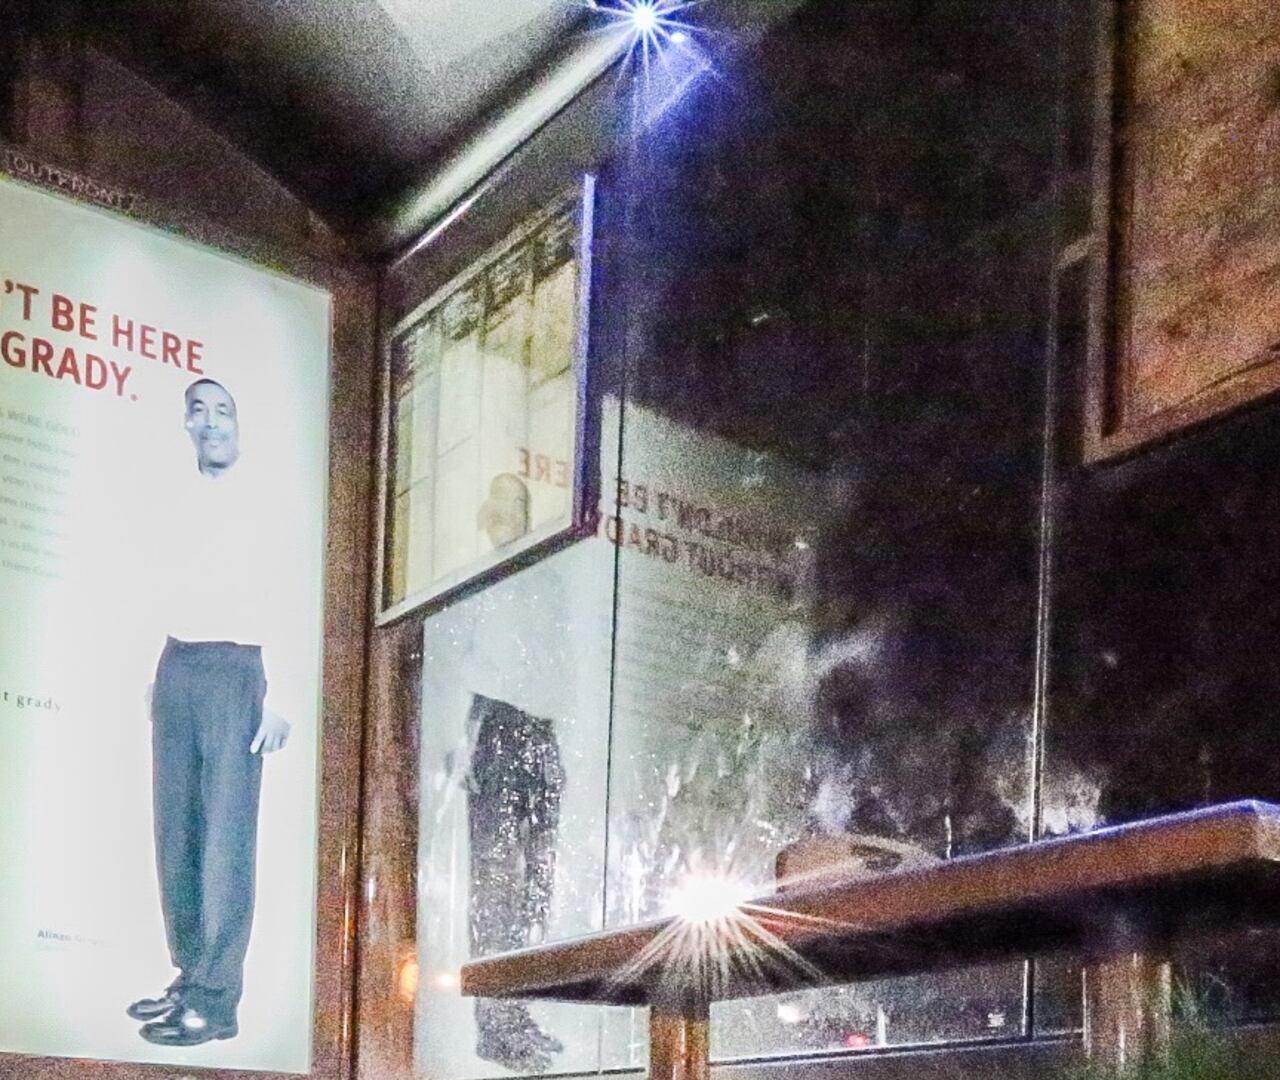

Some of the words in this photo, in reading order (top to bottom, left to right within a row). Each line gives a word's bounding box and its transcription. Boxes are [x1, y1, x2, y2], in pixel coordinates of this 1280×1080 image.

[0, 331, 138, 402] GRADY.
[51, 294, 99, 341] BE
[113, 314, 204, 375] HERE
